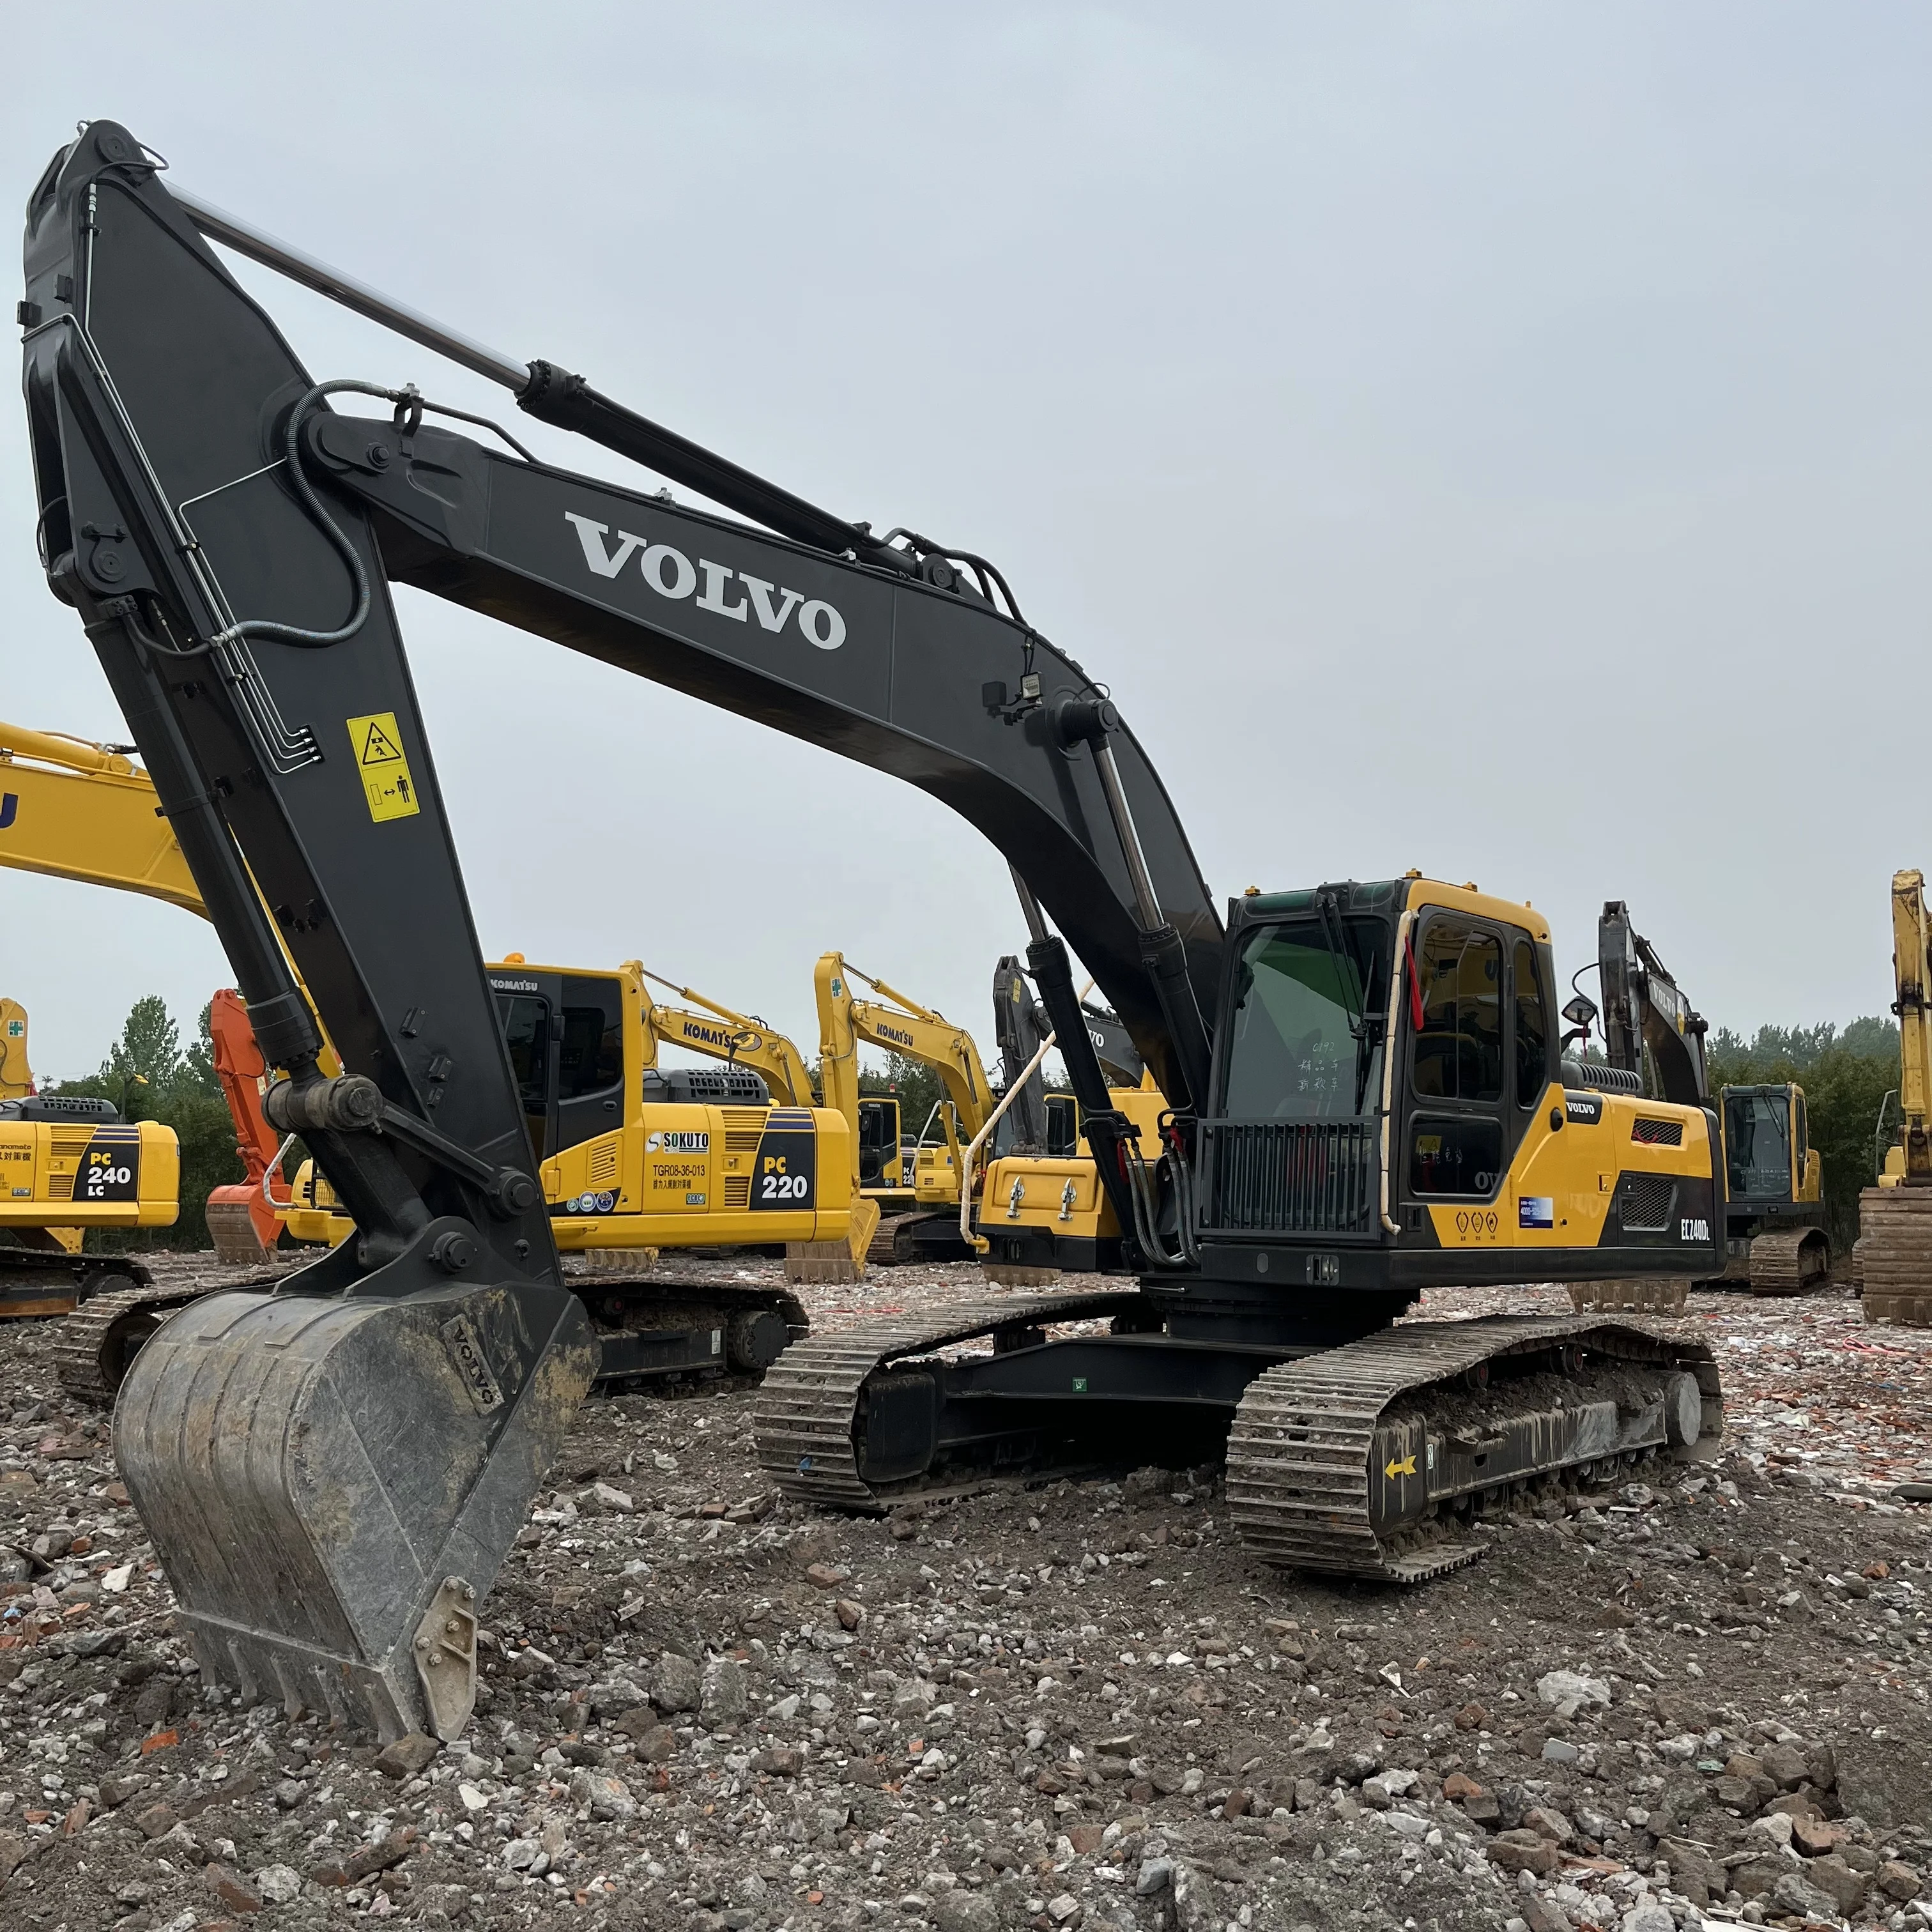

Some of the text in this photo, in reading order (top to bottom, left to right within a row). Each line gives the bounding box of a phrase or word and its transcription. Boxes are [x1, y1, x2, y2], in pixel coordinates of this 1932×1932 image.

[565, 511, 847, 650] VOLVO
[490, 979, 538, 991] KOMATSU
[1652, 982, 1676, 1018] VOLVO
[683, 1022, 735, 1048] KOMATS
[877, 1022, 914, 1046] KOMATSU
[1566, 1101, 1595, 1114] VOLVO
[664, 1132, 709, 1147] SOKUTO
[90, 1153, 112, 1165] PC
[764, 1156, 786, 1174] PC
[88, 1167, 131, 1184] 240
[653, 1165, 705, 1177] TGR08-36-013
[88, 1186, 104, 1196] LC
[762, 1175, 808, 1199] 220
[454, 1324, 493, 1404] VOLVO
